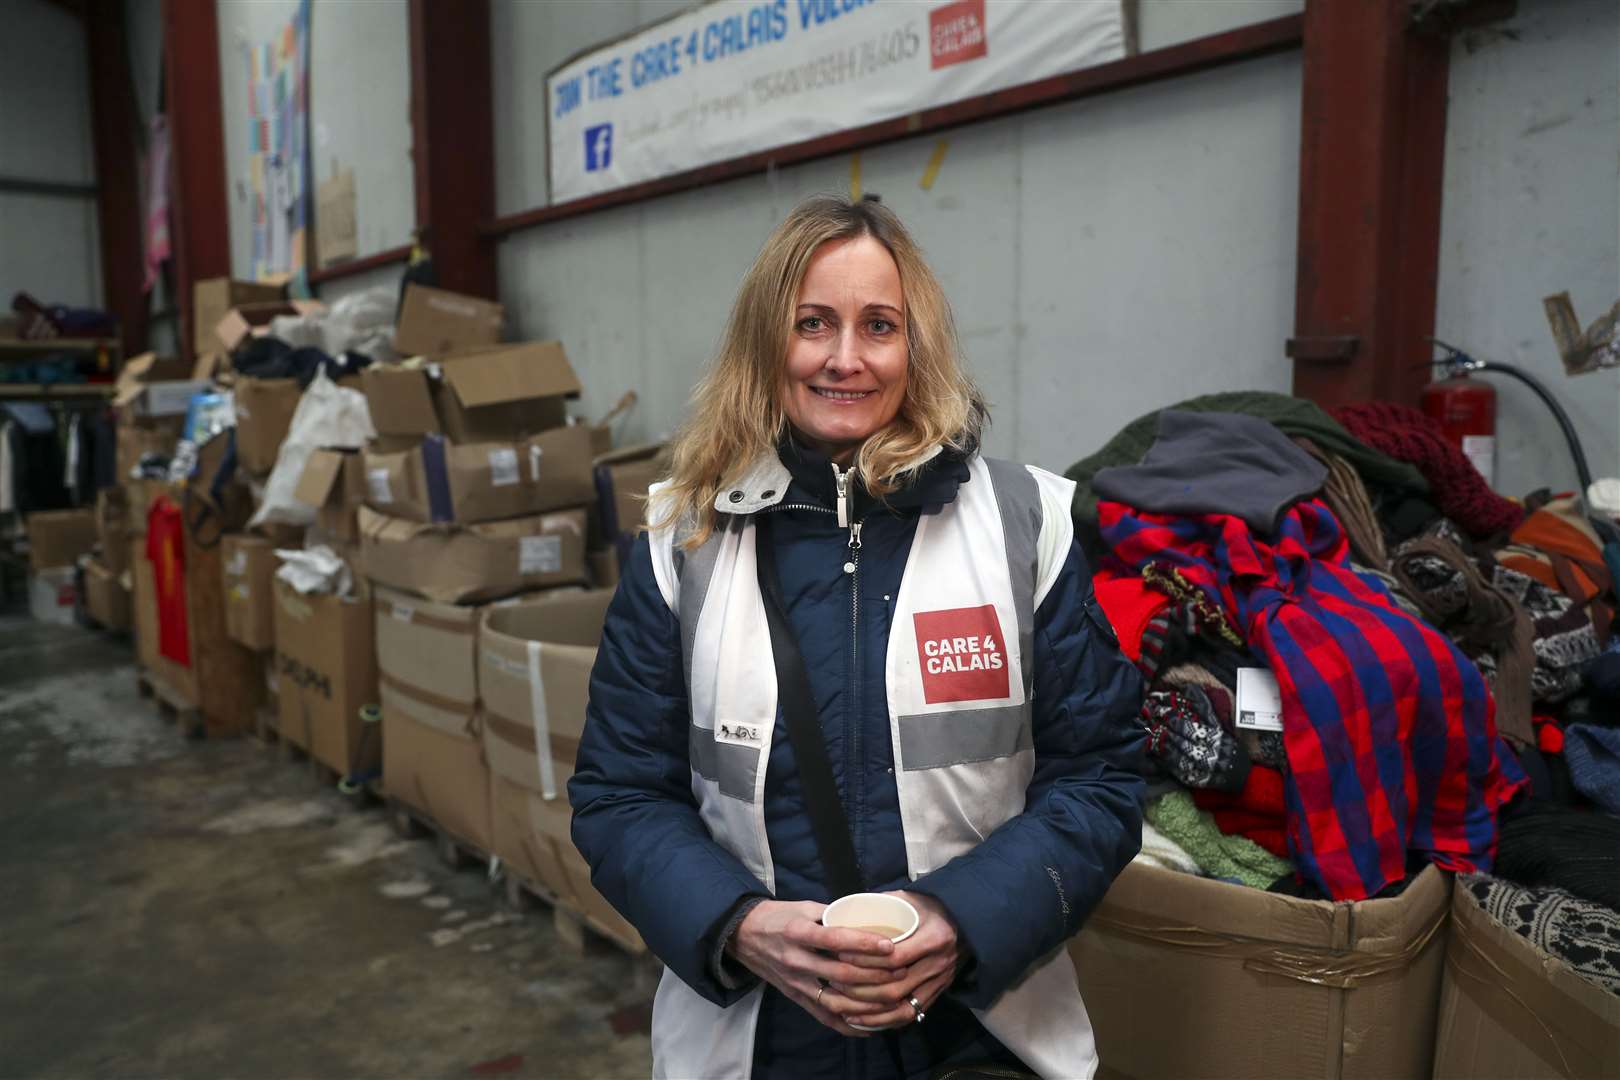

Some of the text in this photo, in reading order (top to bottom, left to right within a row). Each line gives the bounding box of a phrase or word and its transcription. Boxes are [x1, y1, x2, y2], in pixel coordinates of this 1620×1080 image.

[586, 58, 623, 99] THE
[631, 35, 681, 88] CARE
[686, 30, 698, 65] 4
[703, 0, 787, 61] CALAIS
[924, 635, 996, 657] CARE 4
[926, 652, 1003, 674] CALAIS
